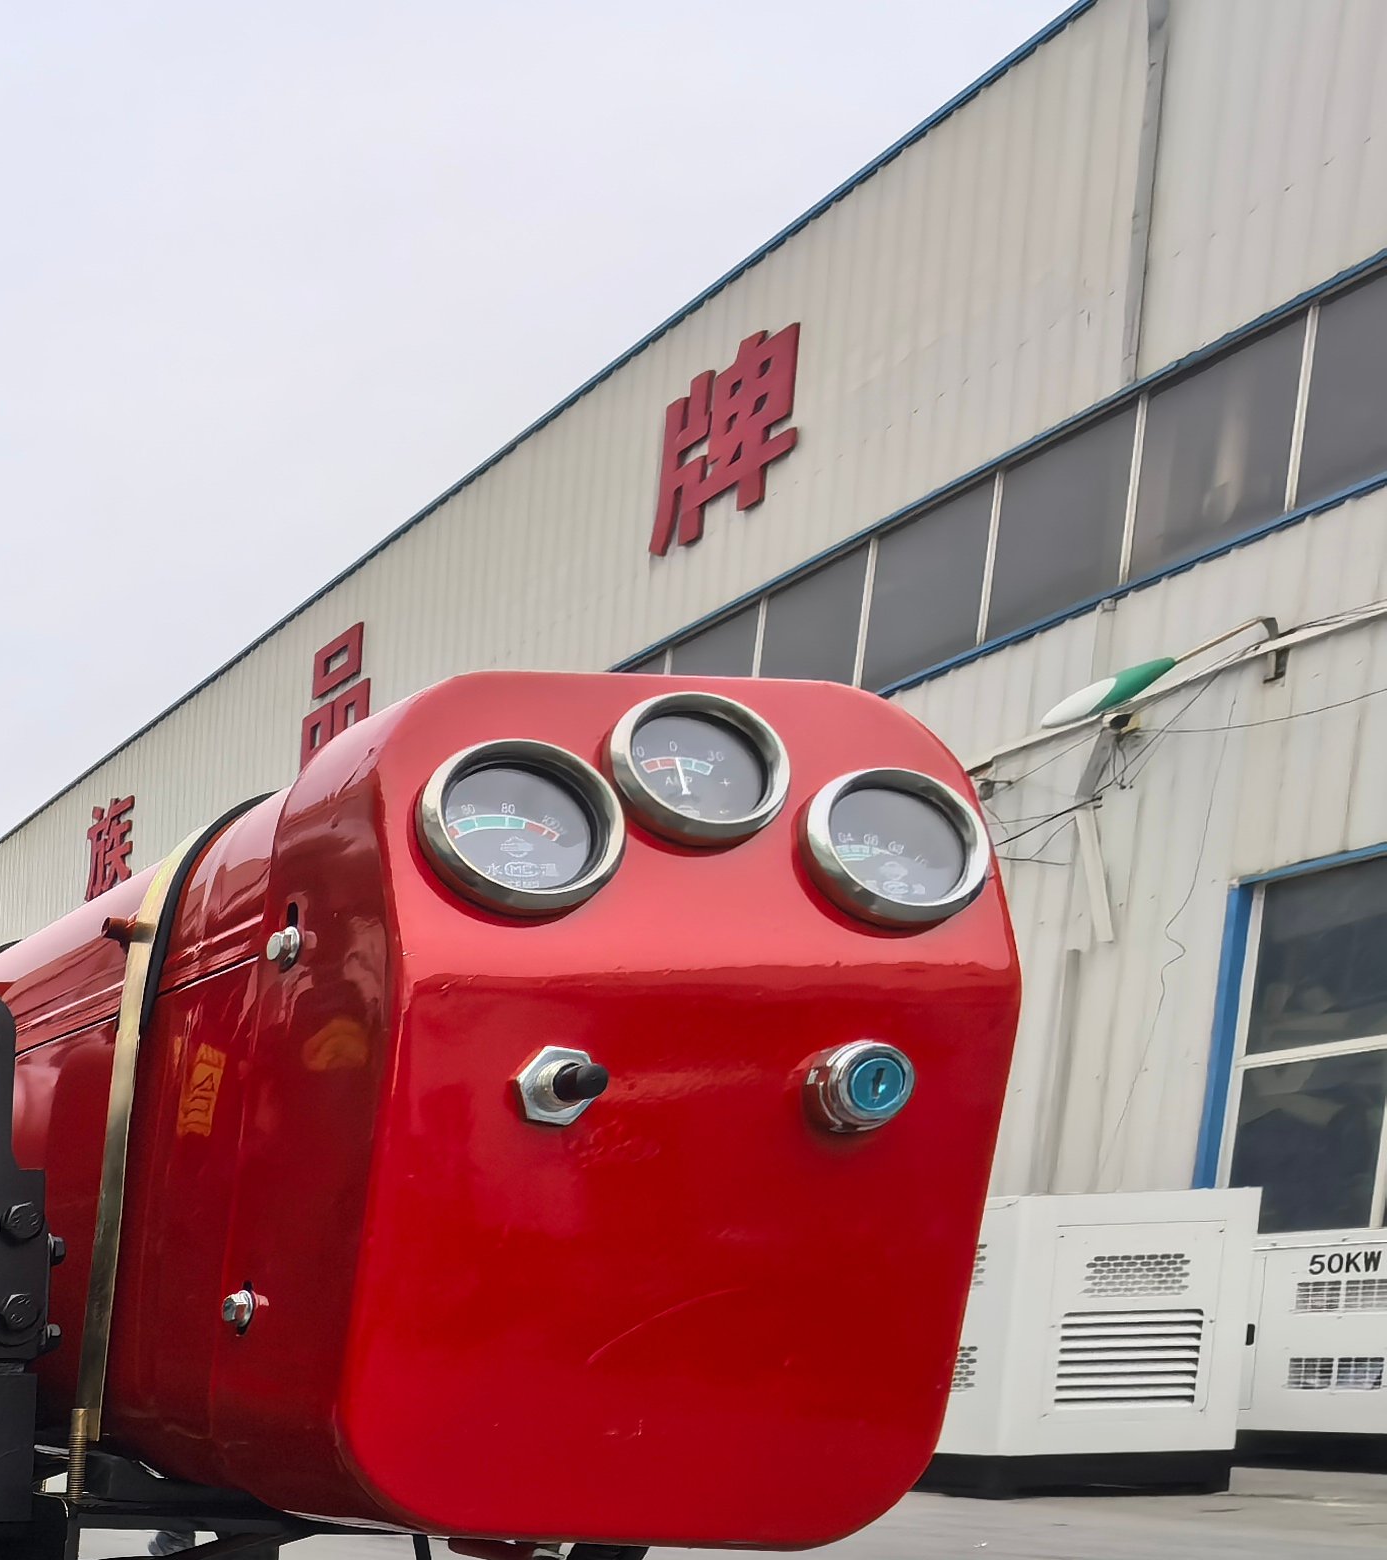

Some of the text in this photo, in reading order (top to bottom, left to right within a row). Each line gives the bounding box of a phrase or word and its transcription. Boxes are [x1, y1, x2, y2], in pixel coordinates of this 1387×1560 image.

[84, 794, 136, 902] 族
[299, 621, 371, 775] 品
[649, 322, 801, 557] 牌
[1308, 1249, 1382, 1276] 50KW
